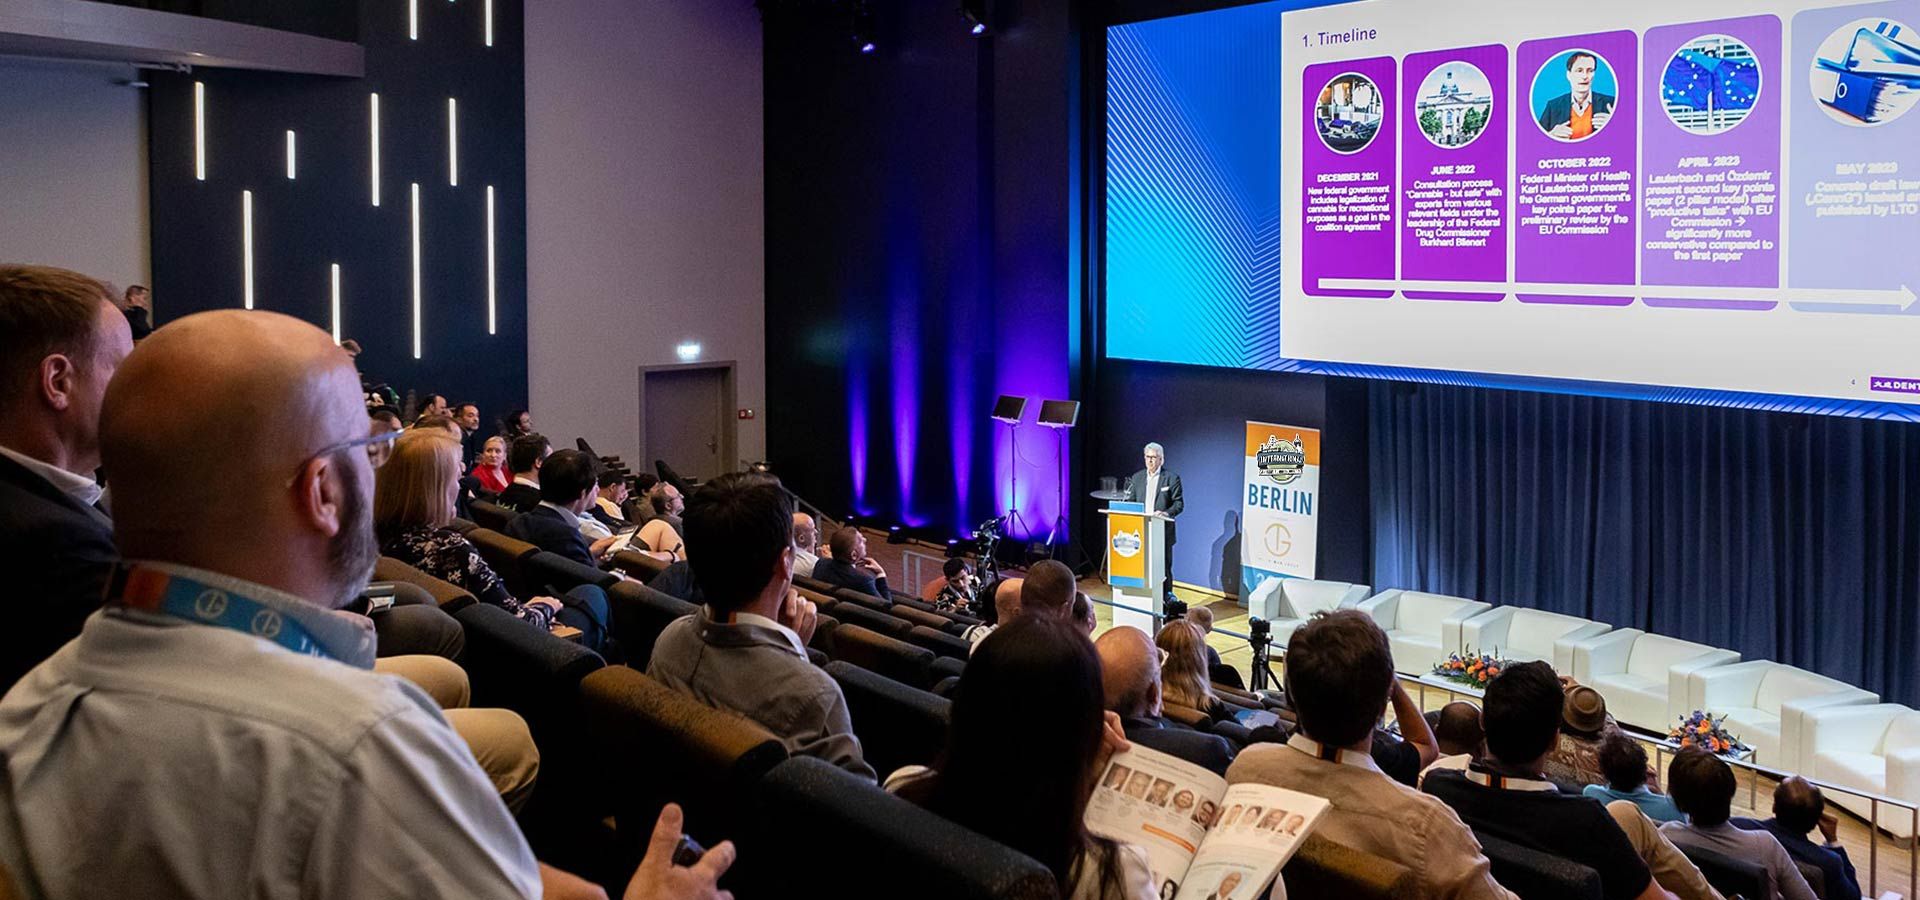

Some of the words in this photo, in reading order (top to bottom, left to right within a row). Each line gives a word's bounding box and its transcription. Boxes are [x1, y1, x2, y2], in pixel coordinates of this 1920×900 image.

[1302, 34, 1312, 47] 1.
[1318, 28, 1376, 46] Timeline
[1538, 158, 1586, 168] OCTOBER
[1588, 157, 1611, 167] 2022
[1678, 157, 1712, 168] APRIL
[1431, 166, 1453, 175] JUNE
[1455, 165, 1475, 173] 2022
[1836, 163, 1865, 174] MAY
[1317, 173, 1360, 182] DECEMBER
[1361, 172, 1379, 180] 2021
[1520, 174, 1552, 183] Federal
[1554, 173, 1588, 182] Minister
[1590, 172, 1599, 181] of
[1601, 171, 1631, 181] Health
[1649, 173, 1703, 183] Lauterbach
[1705, 172, 1724, 181] and
[1414, 180, 1460, 188] Consultation
[1462, 180, 1493, 189] process
[1521, 185, 1538, 193] Karl
[1540, 183, 1588, 193] Lauterbach
[1590, 183, 1629, 193] presents
[1646, 186, 1682, 196] present
[1684, 184, 1720, 194] second
[1722, 183, 1740, 196] key
[1743, 183, 1775, 194] points
[1308, 187, 1323, 195] New
[1324, 186, 1347, 194] federal
[1348, 185, 1390, 195] government
[1450, 189, 1462, 197] but
[1485, 188, 1502, 196] with
[1311, 195, 1338, 204] includes
[1339, 195, 1377, 205] legalization
[1379, 194, 1386, 202] of
[1415, 200, 1442, 208] experts
[1444, 199, 1461, 207] from
[1463, 199, 1491, 207] various
[1519, 195, 1533, 203] the
[1535, 195, 1569, 203] German
[1645, 198, 1673, 207] paper
[1675, 195, 1685, 207] (2
[1687, 195, 1712, 207] pillar
[1713, 193, 1749, 206] model)
[1751, 194, 1776, 203] after
[1307, 204, 1337, 212] cannabis
[1349, 204, 1389, 212] recreational
[1408, 209, 1438, 217] relevant
[1440, 208, 1459, 216] fields
[1461, 208, 1484, 216] under
[1486, 208, 1499, 216] the
[1532, 206, 1547, 215] key
[1549, 205, 1575, 214] points
[1577, 205, 1602, 214] paper
[1605, 204, 1617, 212] for
[1732, 206, 1753, 215] with
[1755, 205, 1773, 215] EU
[1816, 205, 1871, 218] published
[1873, 205, 1888, 217] by
[1891, 203, 1917, 215] LTO
[1307, 215, 1337, 224] purposes
[1354, 213, 1369, 223] goal
[1371, 213, 1377, 221] in
[1379, 213, 1390, 221] the
[1407, 219, 1445, 228] leadership
[1470, 218, 1500, 226] Federal
[1522, 216, 1568, 226] preliminary
[1570, 215, 1598, 223] review
[1600, 215, 1612, 225] by
[1613, 214, 1628, 223] the
[1671, 217, 1732, 226] Commission
[1315, 223, 1343, 231] coalition
[1344, 223, 1381, 232] agreement
[1539, 226, 1552, 234] EU
[1555, 225, 1608, 234] Commission
[1416, 229, 1434, 238] Drug
[1436, 228, 1491, 236] Commissioner
[1666, 228, 1723, 240] significantly
[1725, 230, 1752, 238] more
[1420, 238, 1454, 246] Burkhard
[1646, 240, 1707, 249] conservative
[1709, 240, 1760, 251] compared
[1762, 240, 1773, 249] to
[1674, 251, 1690, 260] the
[1691, 250, 1711, 260] first
[1712, 252, 1743, 262] paper
[1248, 484, 1312, 516] BERLIN
